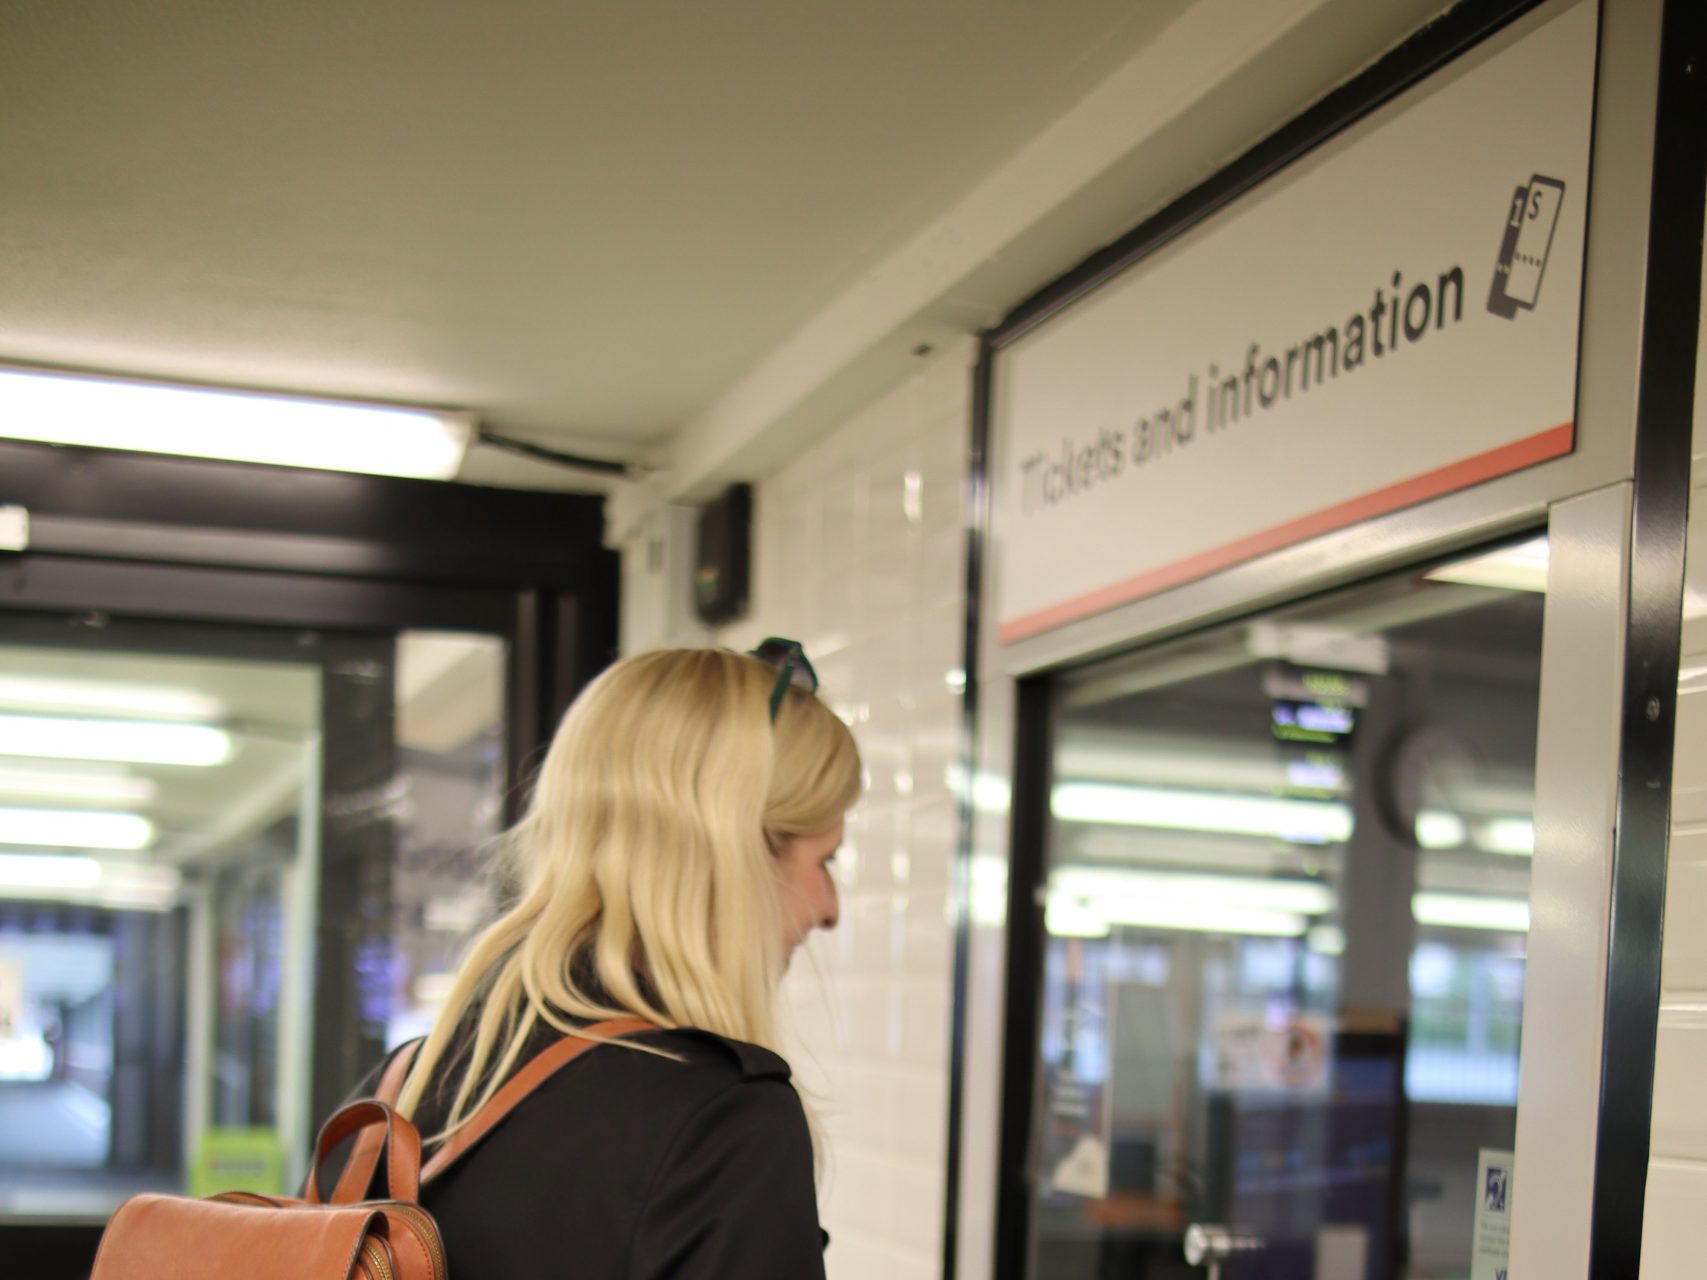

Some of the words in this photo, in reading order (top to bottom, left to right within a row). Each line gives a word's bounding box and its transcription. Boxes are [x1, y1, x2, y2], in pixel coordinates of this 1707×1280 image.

[1020, 426, 1126, 516] Tickets
[1132, 374, 1199, 466] and
[1206, 264, 1465, 434] information
